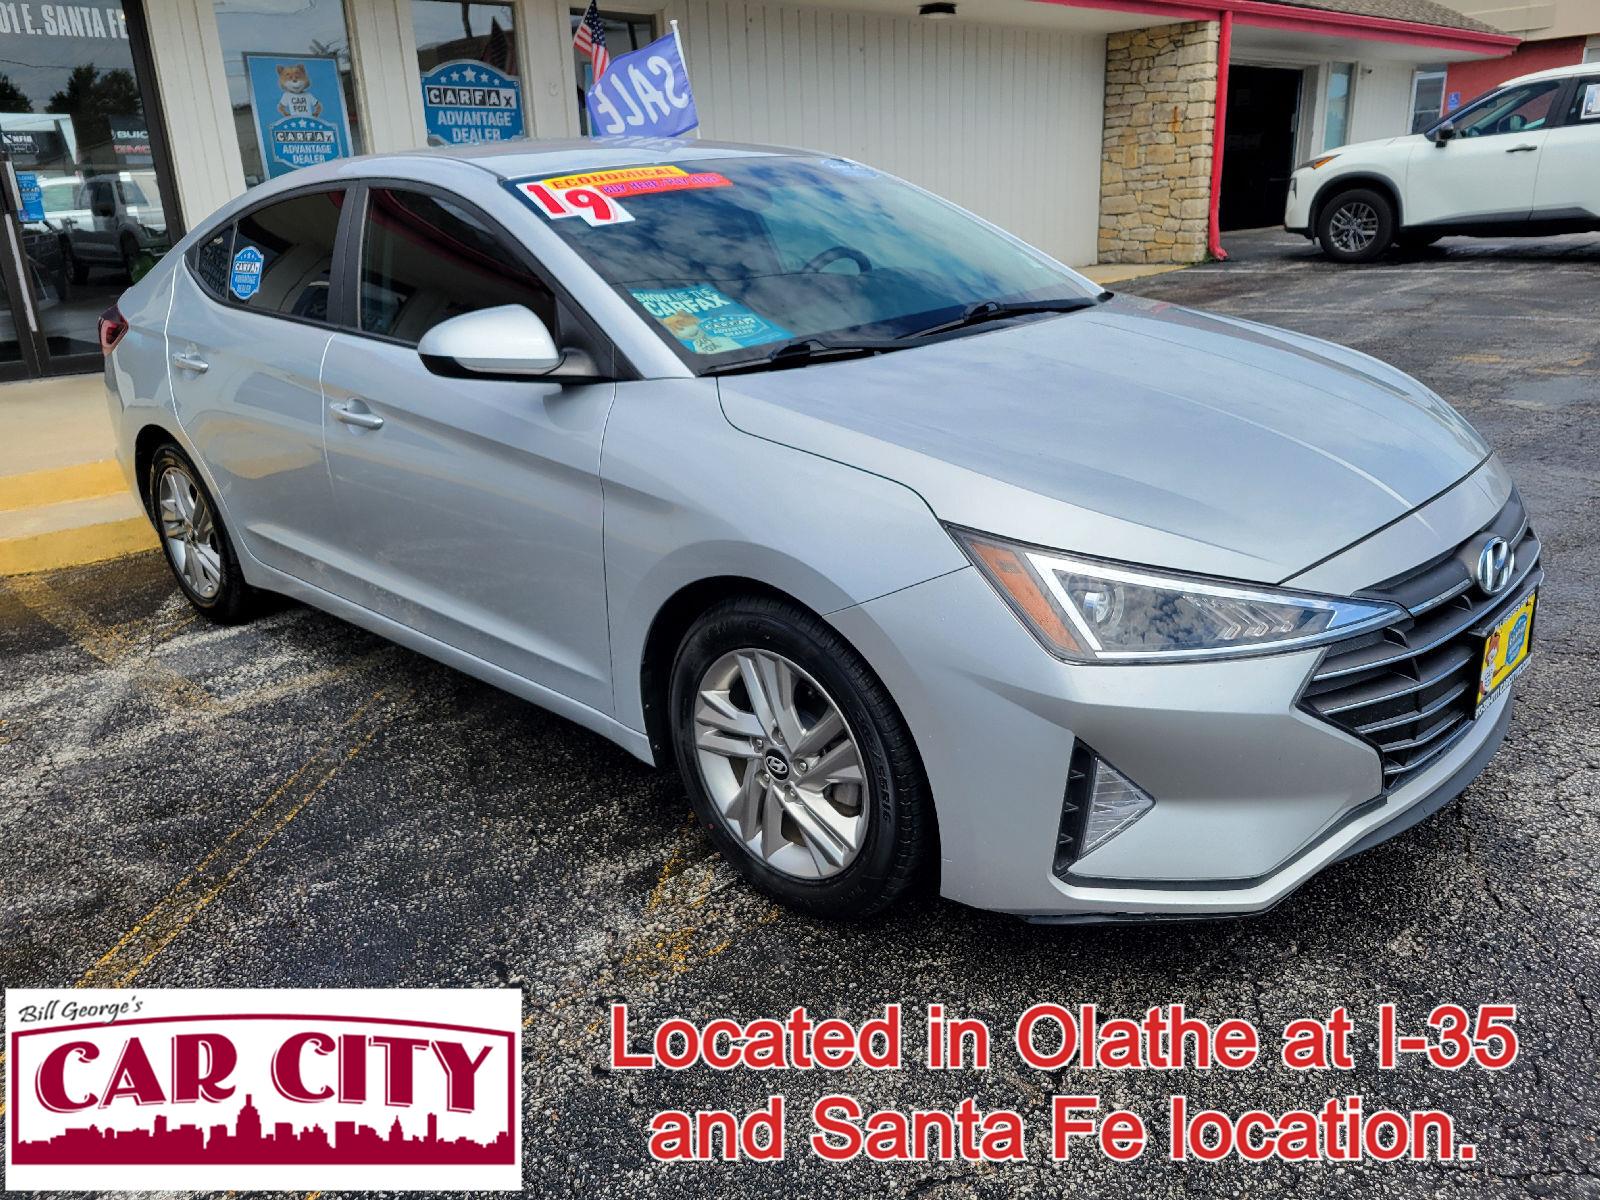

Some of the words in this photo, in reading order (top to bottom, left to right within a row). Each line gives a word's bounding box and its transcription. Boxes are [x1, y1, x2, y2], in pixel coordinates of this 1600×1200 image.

[20, 3, 42, 35] E.
[41, 5, 107, 38] SANTA
[106, 8, 129, 39] FE
[429, 88, 513, 108] CARFAX
[437, 110, 513, 126] ADVANTAGE
[276, 132, 334, 142] CARFAX
[452, 127, 501, 144] DEALER
[283, 144, 333, 154] ADVANTAGE
[292, 154, 326, 163] DEALER
[551, 166, 679, 189] ECONOMICAL
[526, 184, 611, 221] 19
[643, 294, 731, 316] CARFAX
